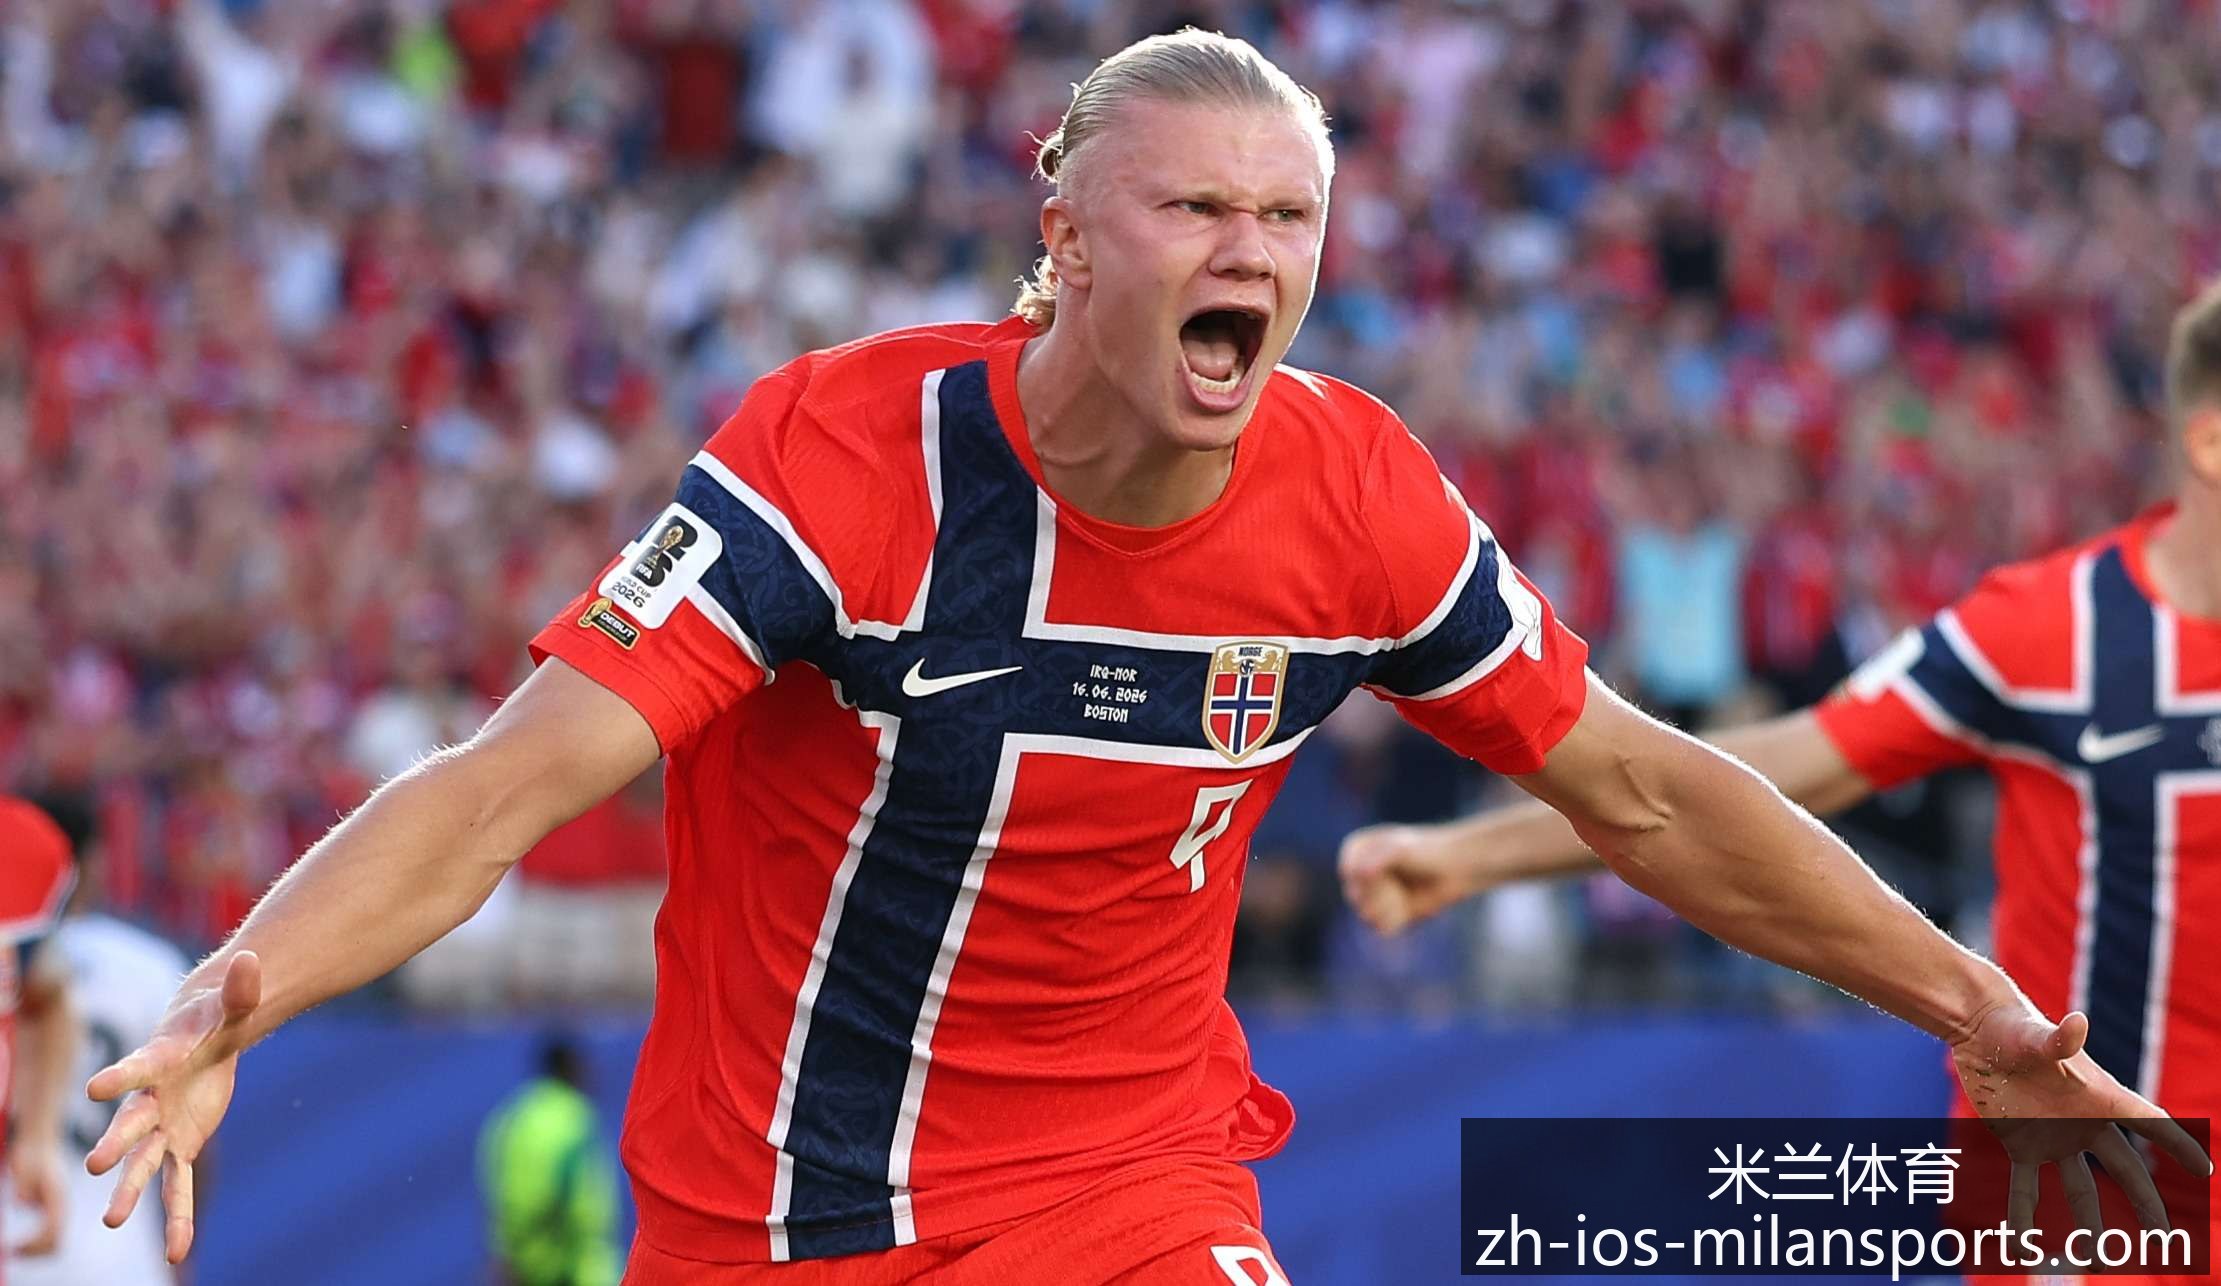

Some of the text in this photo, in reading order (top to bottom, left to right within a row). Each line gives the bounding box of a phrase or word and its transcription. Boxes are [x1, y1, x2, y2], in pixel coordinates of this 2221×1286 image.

[635, 563, 653, 580] FIFA
[611, 581, 646, 609] 2026
[636, 585, 652, 599] CUP
[600, 612, 636, 638] DEBUT
[1090, 664, 1138, 682] IRQ-NOR
[1083, 703, 1129, 724] BOSTON
[1169, 778, 1253, 893] 9
